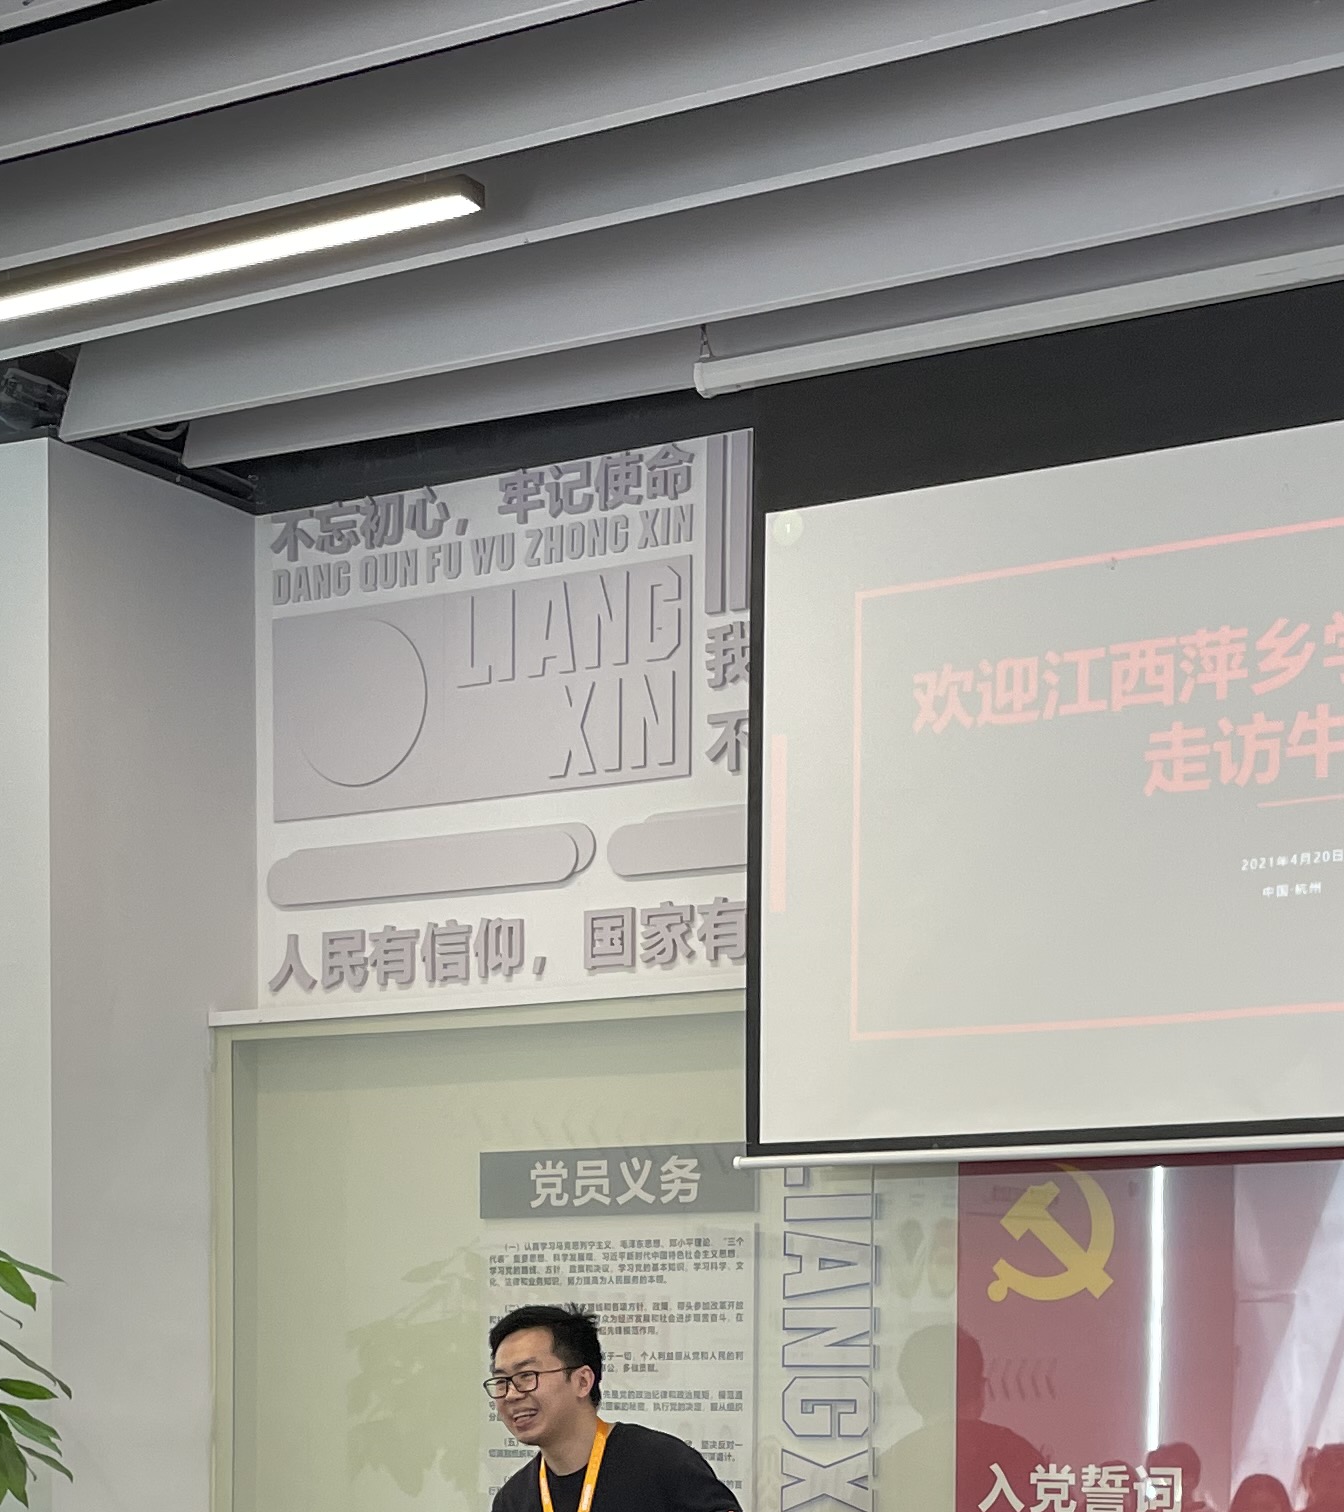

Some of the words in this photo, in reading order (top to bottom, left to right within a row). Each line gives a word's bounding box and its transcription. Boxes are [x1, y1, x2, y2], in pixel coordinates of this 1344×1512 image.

[270, 442, 695, 562] 不忘初心，牢记使命
[272, 561, 351, 605] DANG
[358, 549, 418, 592] QUN
[426, 540, 462, 583] FU
[471, 534, 515, 576] WU
[524, 512, 629, 567] ZHONG
[638, 503, 695, 549] XIN
[456, 565, 683, 688] LIANG
[548, 670, 677, 779] XIN
[1241, 849, 1344, 871] 2021年4月20日
[269, 897, 749, 992] 人民有信仰，国家有
[529, 1156, 701, 1209] 党员义务
